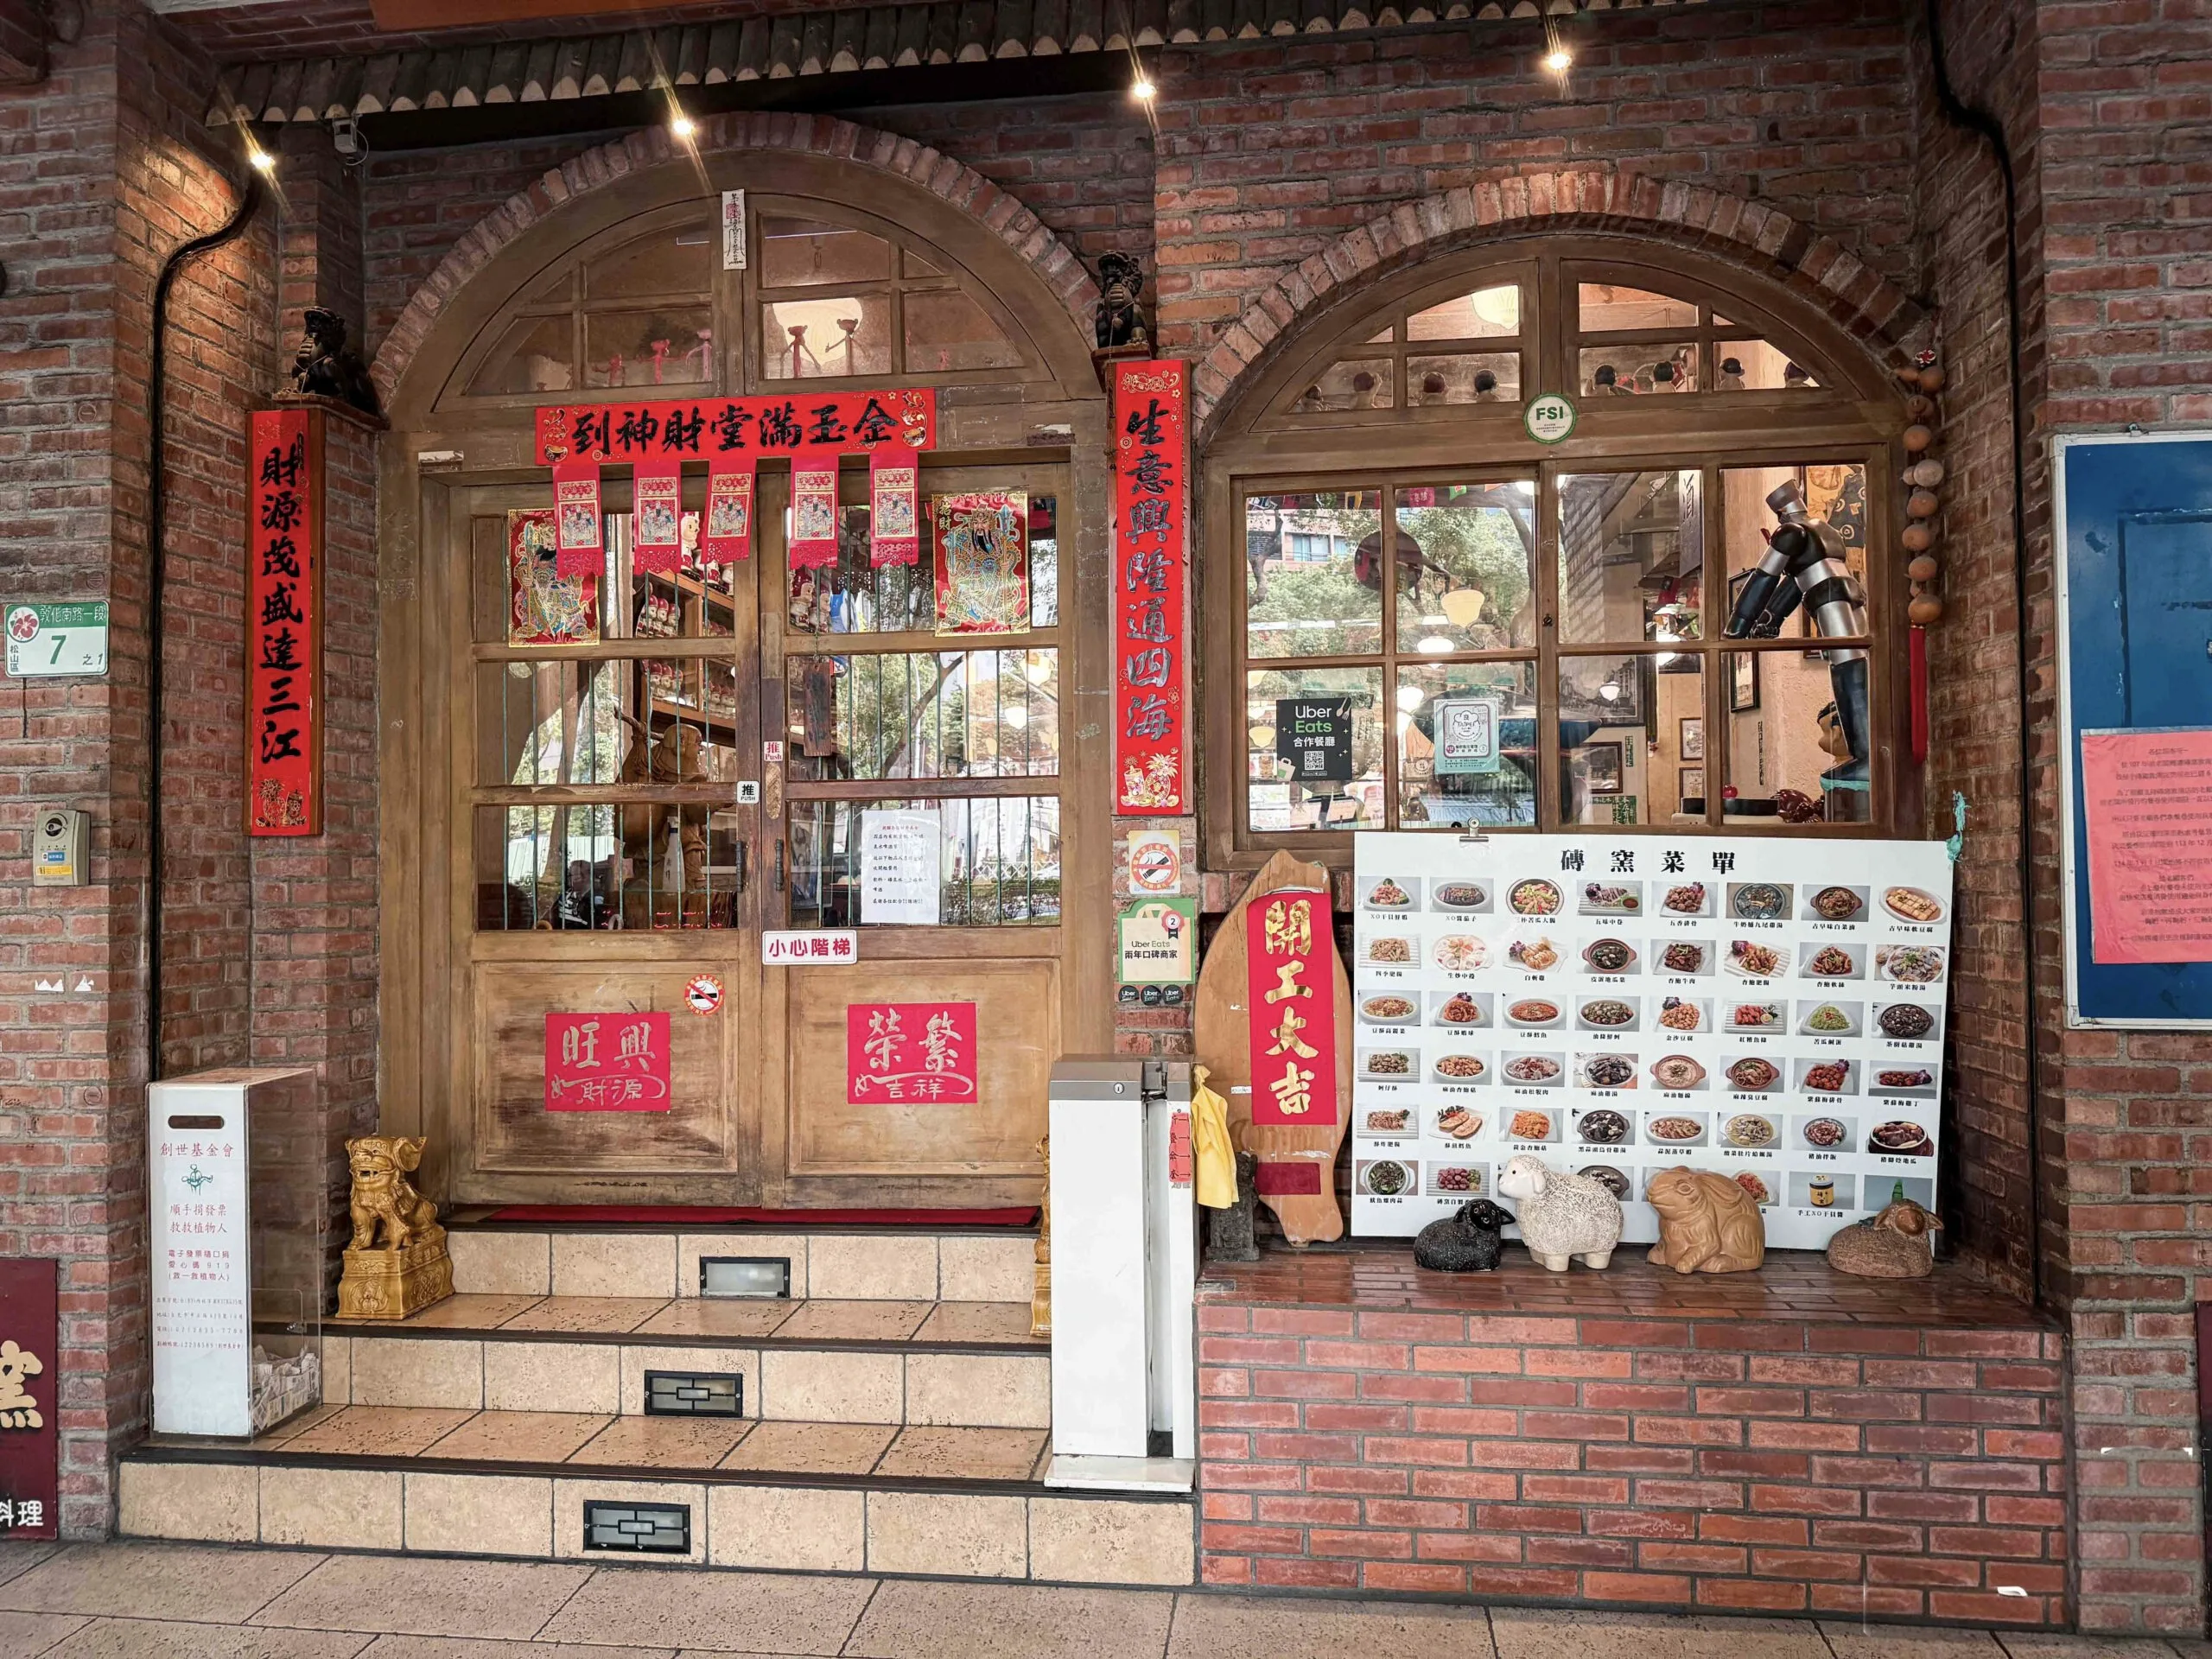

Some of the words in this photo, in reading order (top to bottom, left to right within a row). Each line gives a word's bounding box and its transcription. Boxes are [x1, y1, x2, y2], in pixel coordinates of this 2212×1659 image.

[1535, 406, 1564, 421] FSI
[1125, 399, 1175, 741] 生意興隆通四海
[260, 447, 303, 764] 財源茂盛達三江
[40, 605, 106, 623] 敦化南路一段
[50, 635, 67, 664] 7
[10, 645, 19, 672] 松山區
[1295, 705, 1332, 719] Uber
[1295, 721, 1332, 734] Eats
[766, 741, 780, 753] 推
[1293, 736, 1336, 747] 合作餐廳
[741, 784, 755, 796] 推
[1560, 849, 1735, 875] 磚窯菜單
[768, 938, 851, 957] 小心階梯
[1124, 950, 1178, 959] 兩年口碑商家
[1263, 899, 1319, 1116] 開工大吉
[161, 1141, 234, 1158] 創世基金會
[170, 1203, 227, 1217] 順手捐發票
[170, 1221, 227, 1234] 救救植物人
